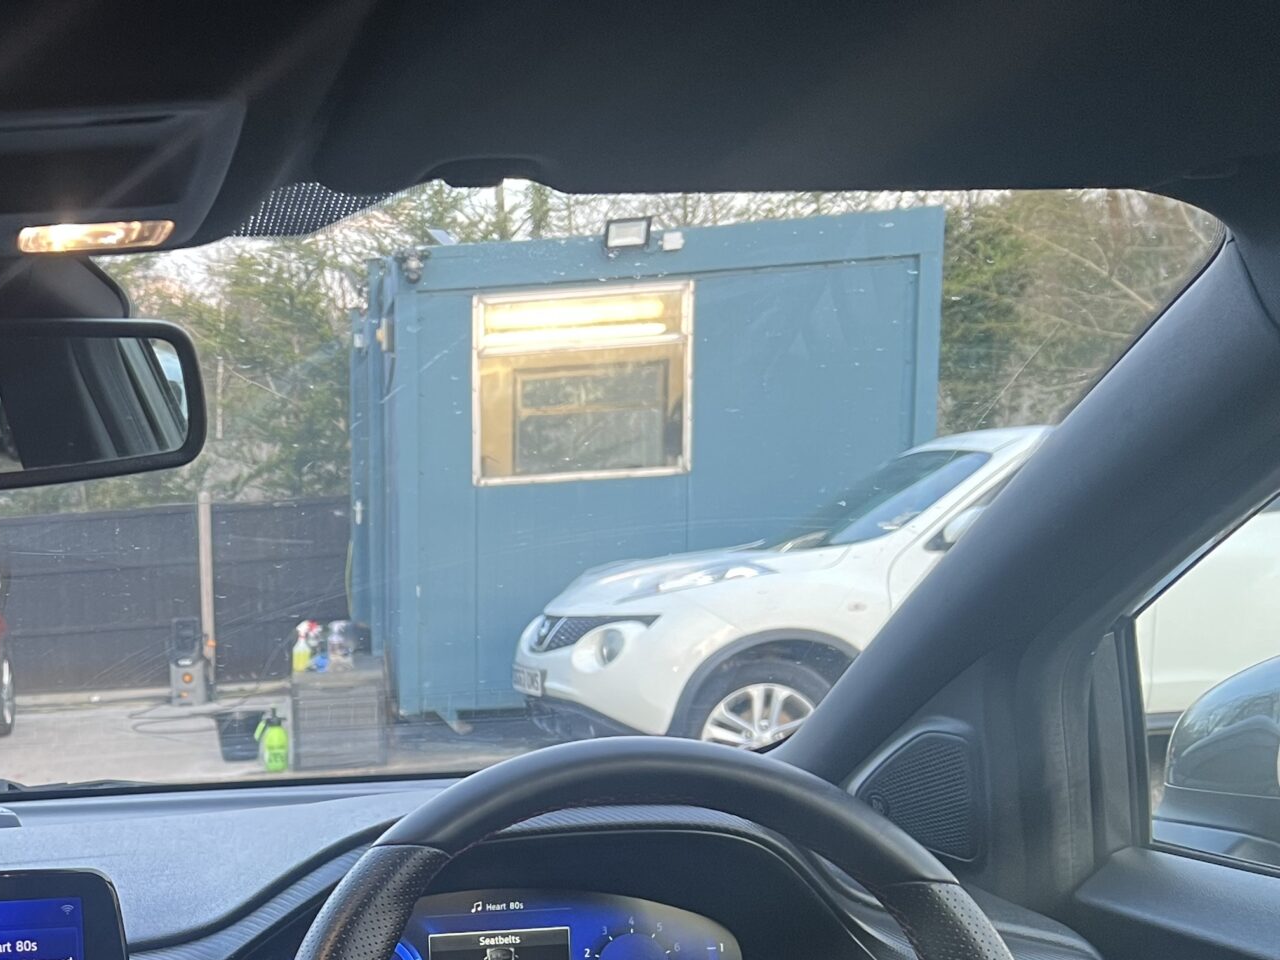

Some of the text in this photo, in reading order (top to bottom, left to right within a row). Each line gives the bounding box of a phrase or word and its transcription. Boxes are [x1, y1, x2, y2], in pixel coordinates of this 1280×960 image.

[485, 902, 524, 911] Heart 80s
[628, 917, 635, 926] 4
[602, 926, 608, 935] 3
[657, 922, 663, 932] 5
[479, 935, 521, 946] Seatbelts
[15, 940, 38, 952] 80s
[674, 942, 680, 951] 6
[584, 948, 590, 958] 2
